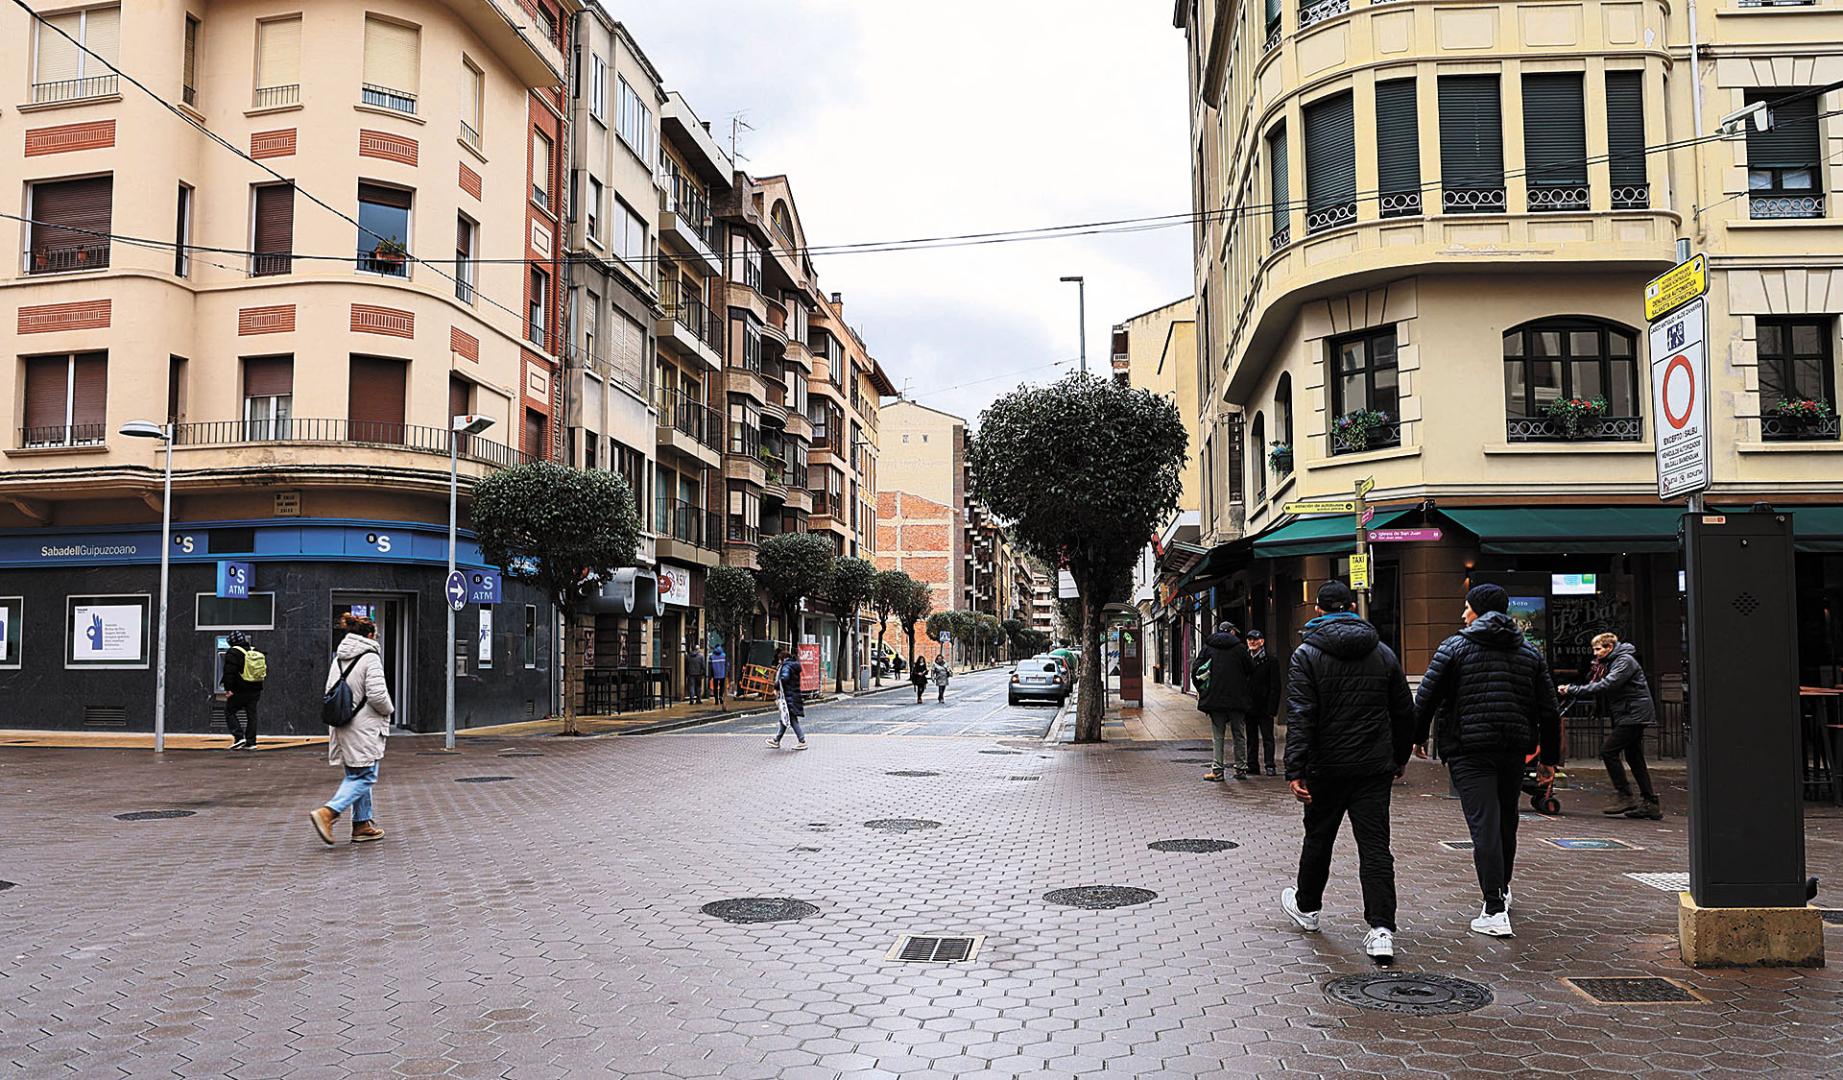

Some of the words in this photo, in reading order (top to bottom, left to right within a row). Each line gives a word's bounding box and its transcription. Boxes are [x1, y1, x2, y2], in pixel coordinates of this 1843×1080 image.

[1663, 432, 1682, 445] EXCEPTO
[1352, 555, 1365, 564] TAXI
[228, 585, 245, 595] ATM
[472, 592, 494, 601] ATM
